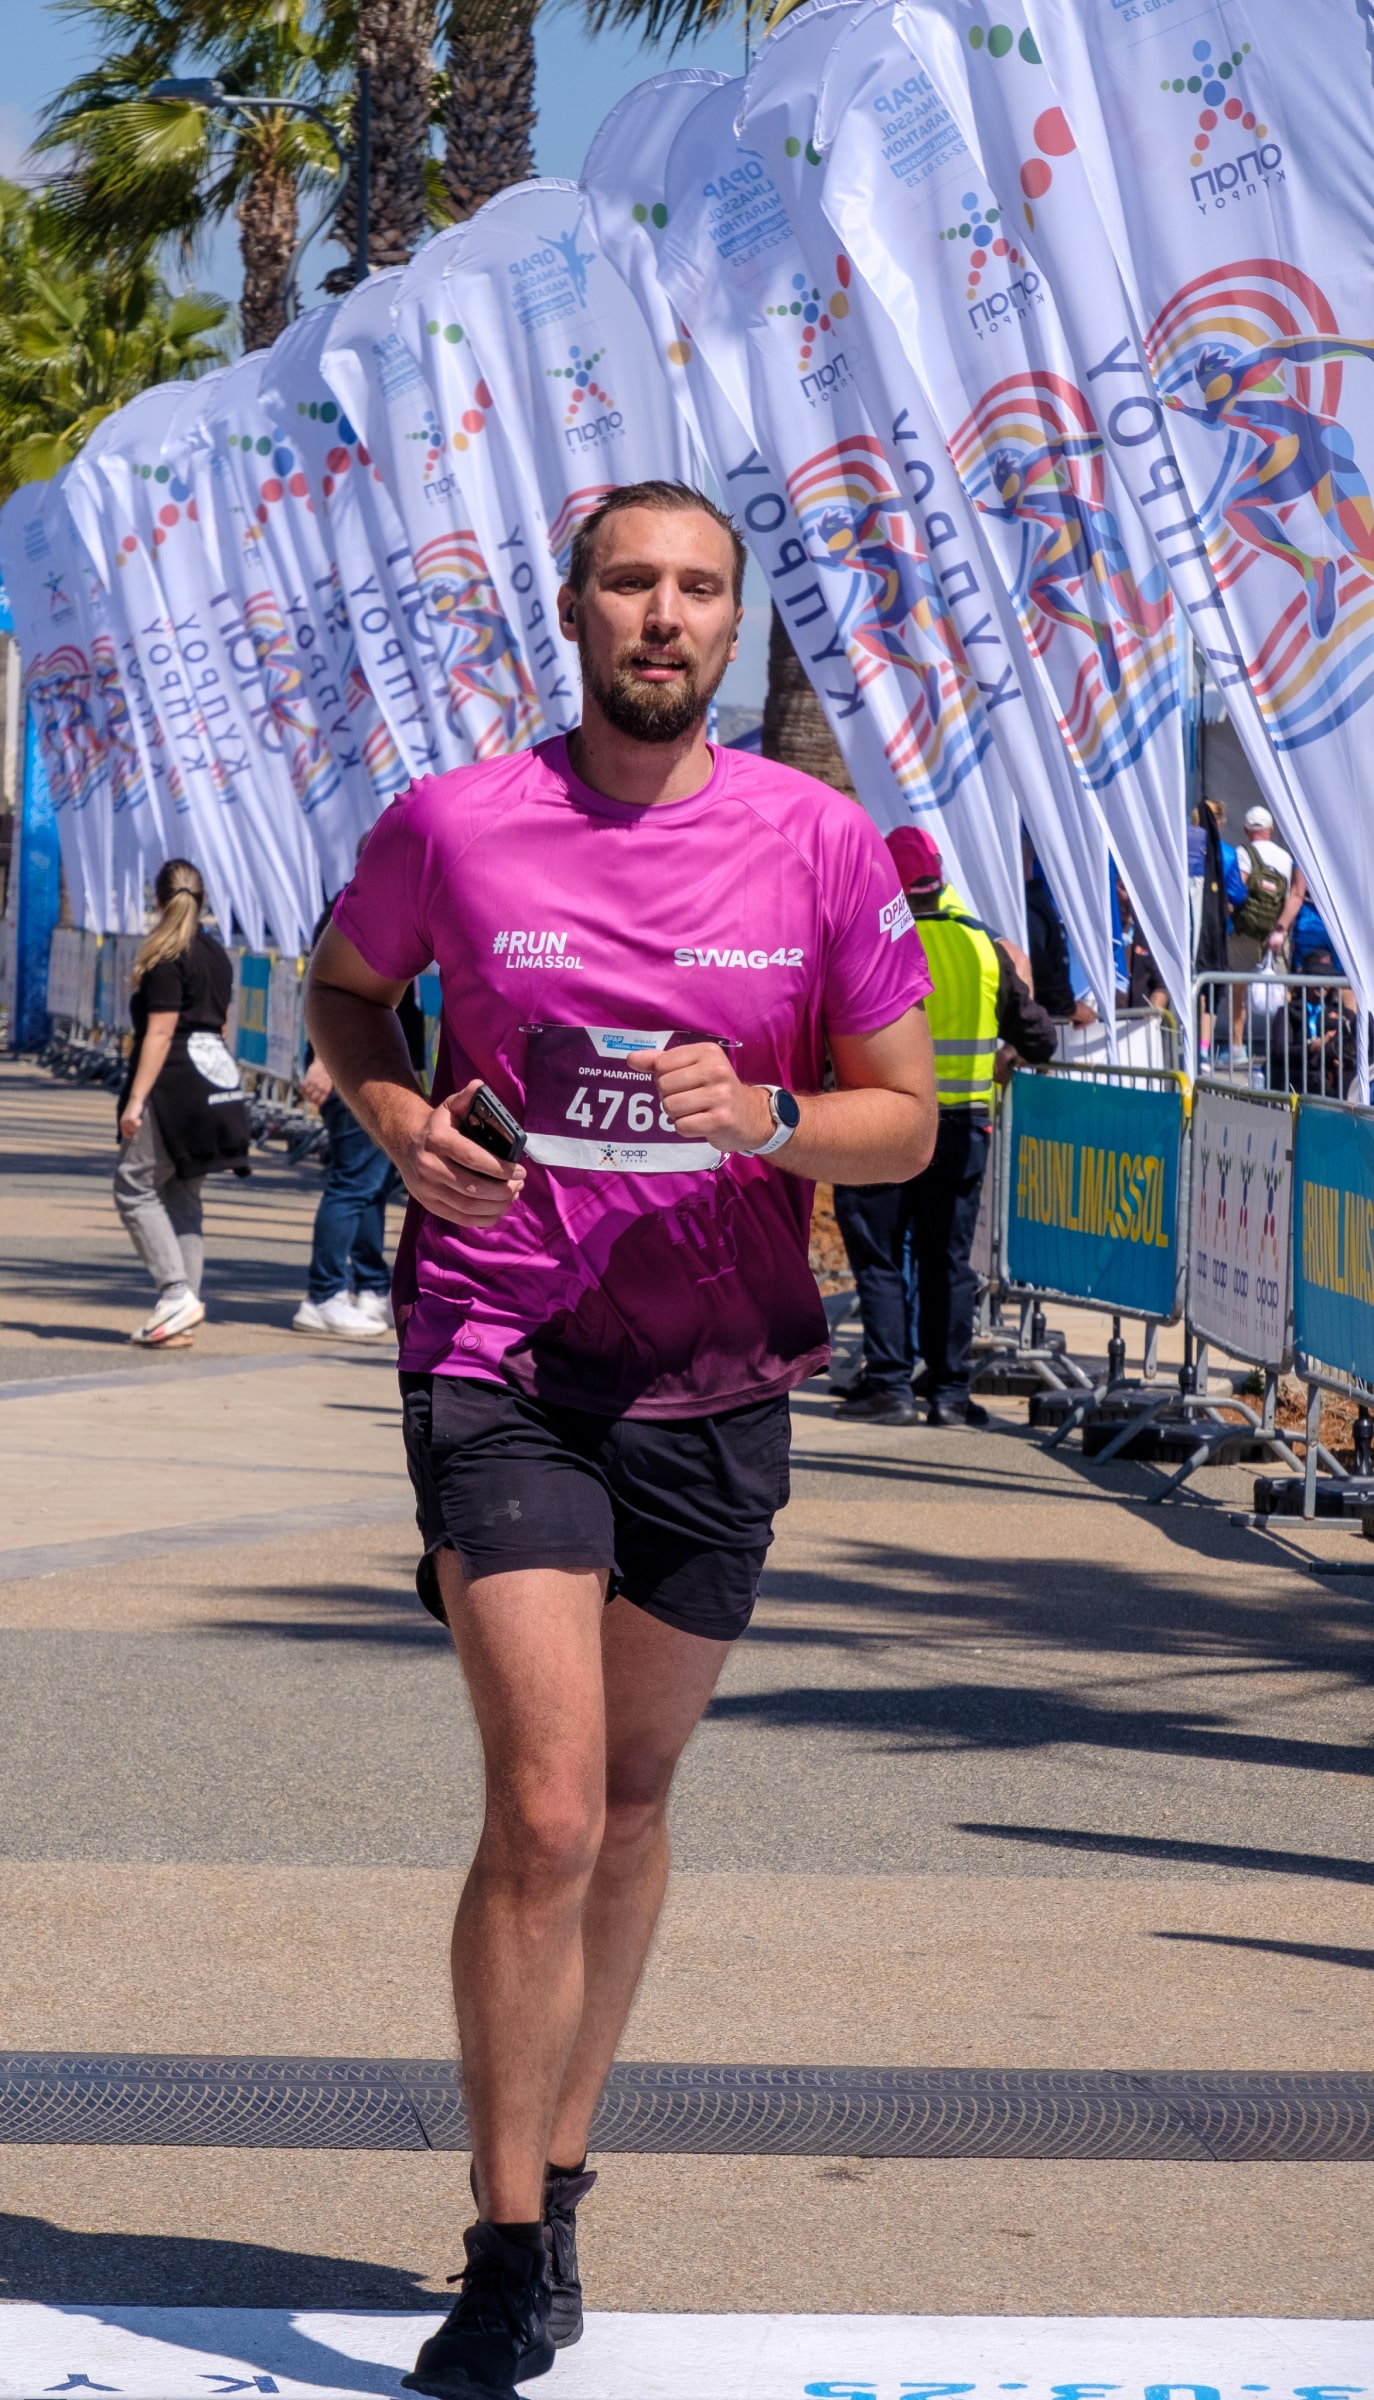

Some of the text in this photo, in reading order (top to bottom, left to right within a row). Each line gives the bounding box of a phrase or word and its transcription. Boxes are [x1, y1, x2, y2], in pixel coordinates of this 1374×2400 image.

[493, 931, 568, 955] #RUN
[505, 955, 585, 970] LIMASSOL
[674, 948, 805, 969] SWAG42
[578, 1067, 653, 1082] OPAP MARATHON
[620, 1149, 648, 1160] opap
[1017, 1134, 1169, 1249] #RUNLIMASSOL
[1256, 1277, 1280, 1320] opap
[1255, 1319, 1280, 1338] CYPRUS
